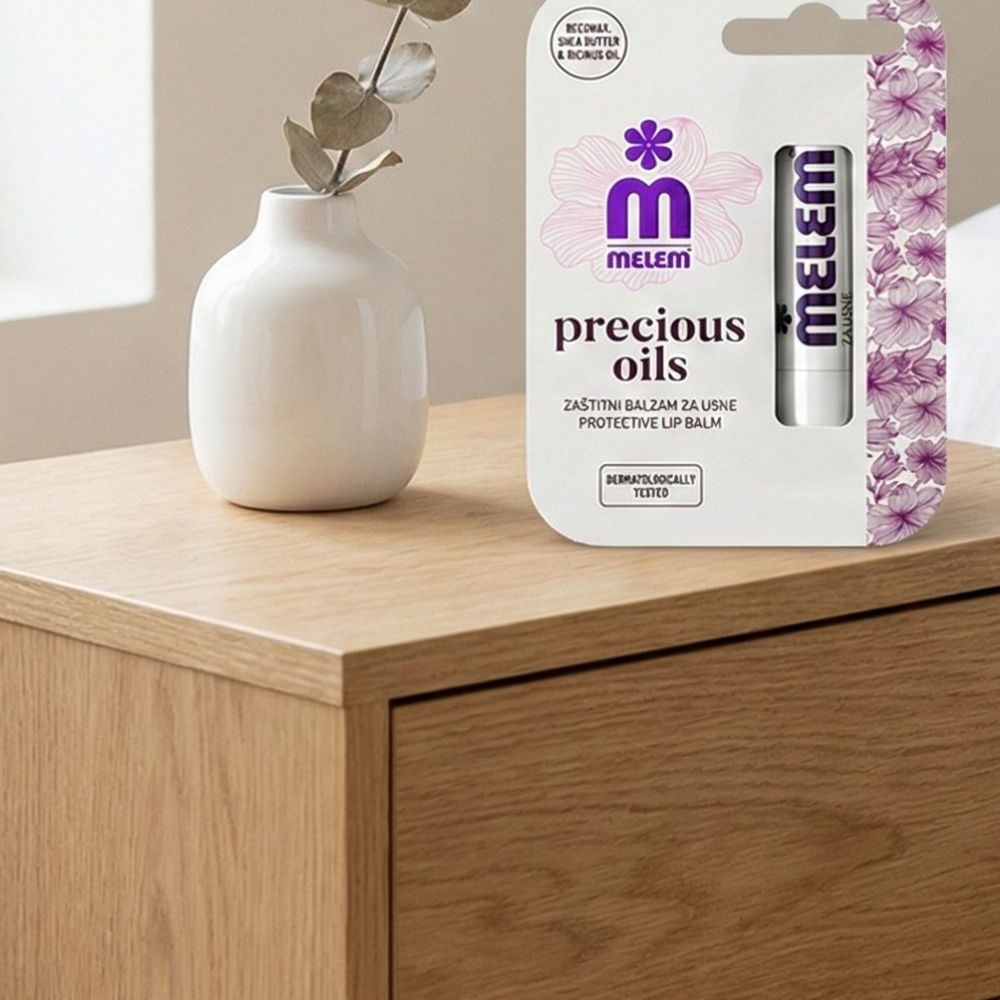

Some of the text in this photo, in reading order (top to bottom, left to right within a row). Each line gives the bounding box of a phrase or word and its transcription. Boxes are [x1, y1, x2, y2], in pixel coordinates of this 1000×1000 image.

[555, 307, 745, 352] precious
[613, 346, 688, 382] oils
[563, 397, 738, 412] ZAŠTITNI BALZAM ZA USNE
[579, 416, 722, 429] PROTECTIVE LIP BALM
